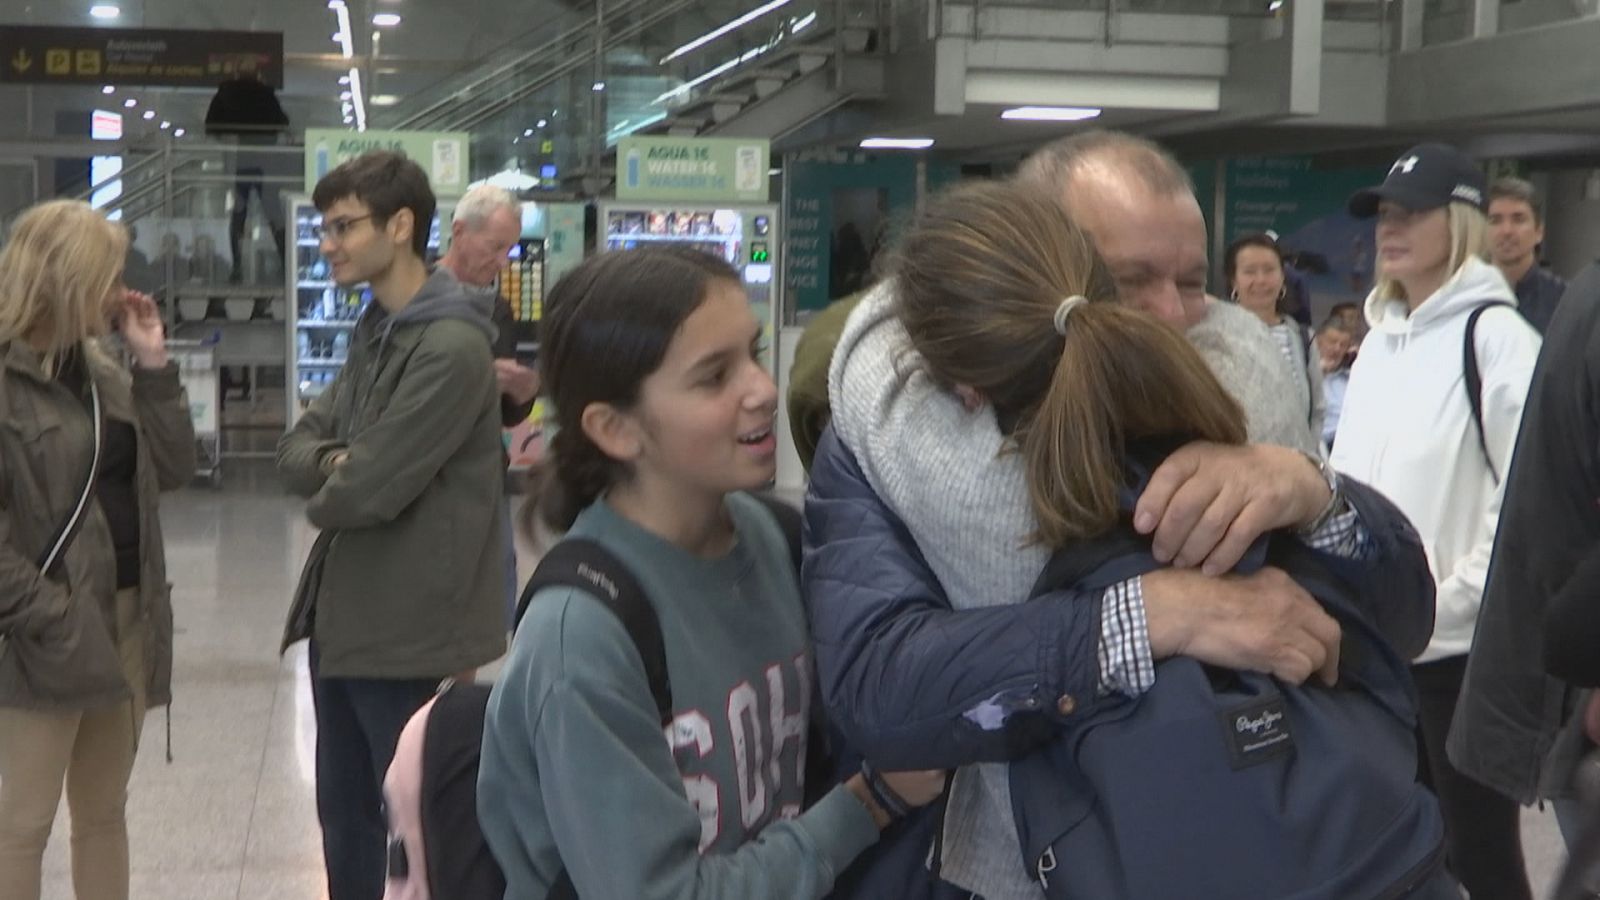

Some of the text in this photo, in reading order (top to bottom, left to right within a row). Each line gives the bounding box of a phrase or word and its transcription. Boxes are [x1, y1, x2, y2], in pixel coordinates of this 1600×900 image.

[337, 139, 381, 153] AGUA
[648, 146, 690, 159] AGUA
[648, 160, 698, 174] WATER
[648, 176, 706, 187] WASSER
[796, 200, 819, 211] THE
[664, 655, 812, 856] SOH
